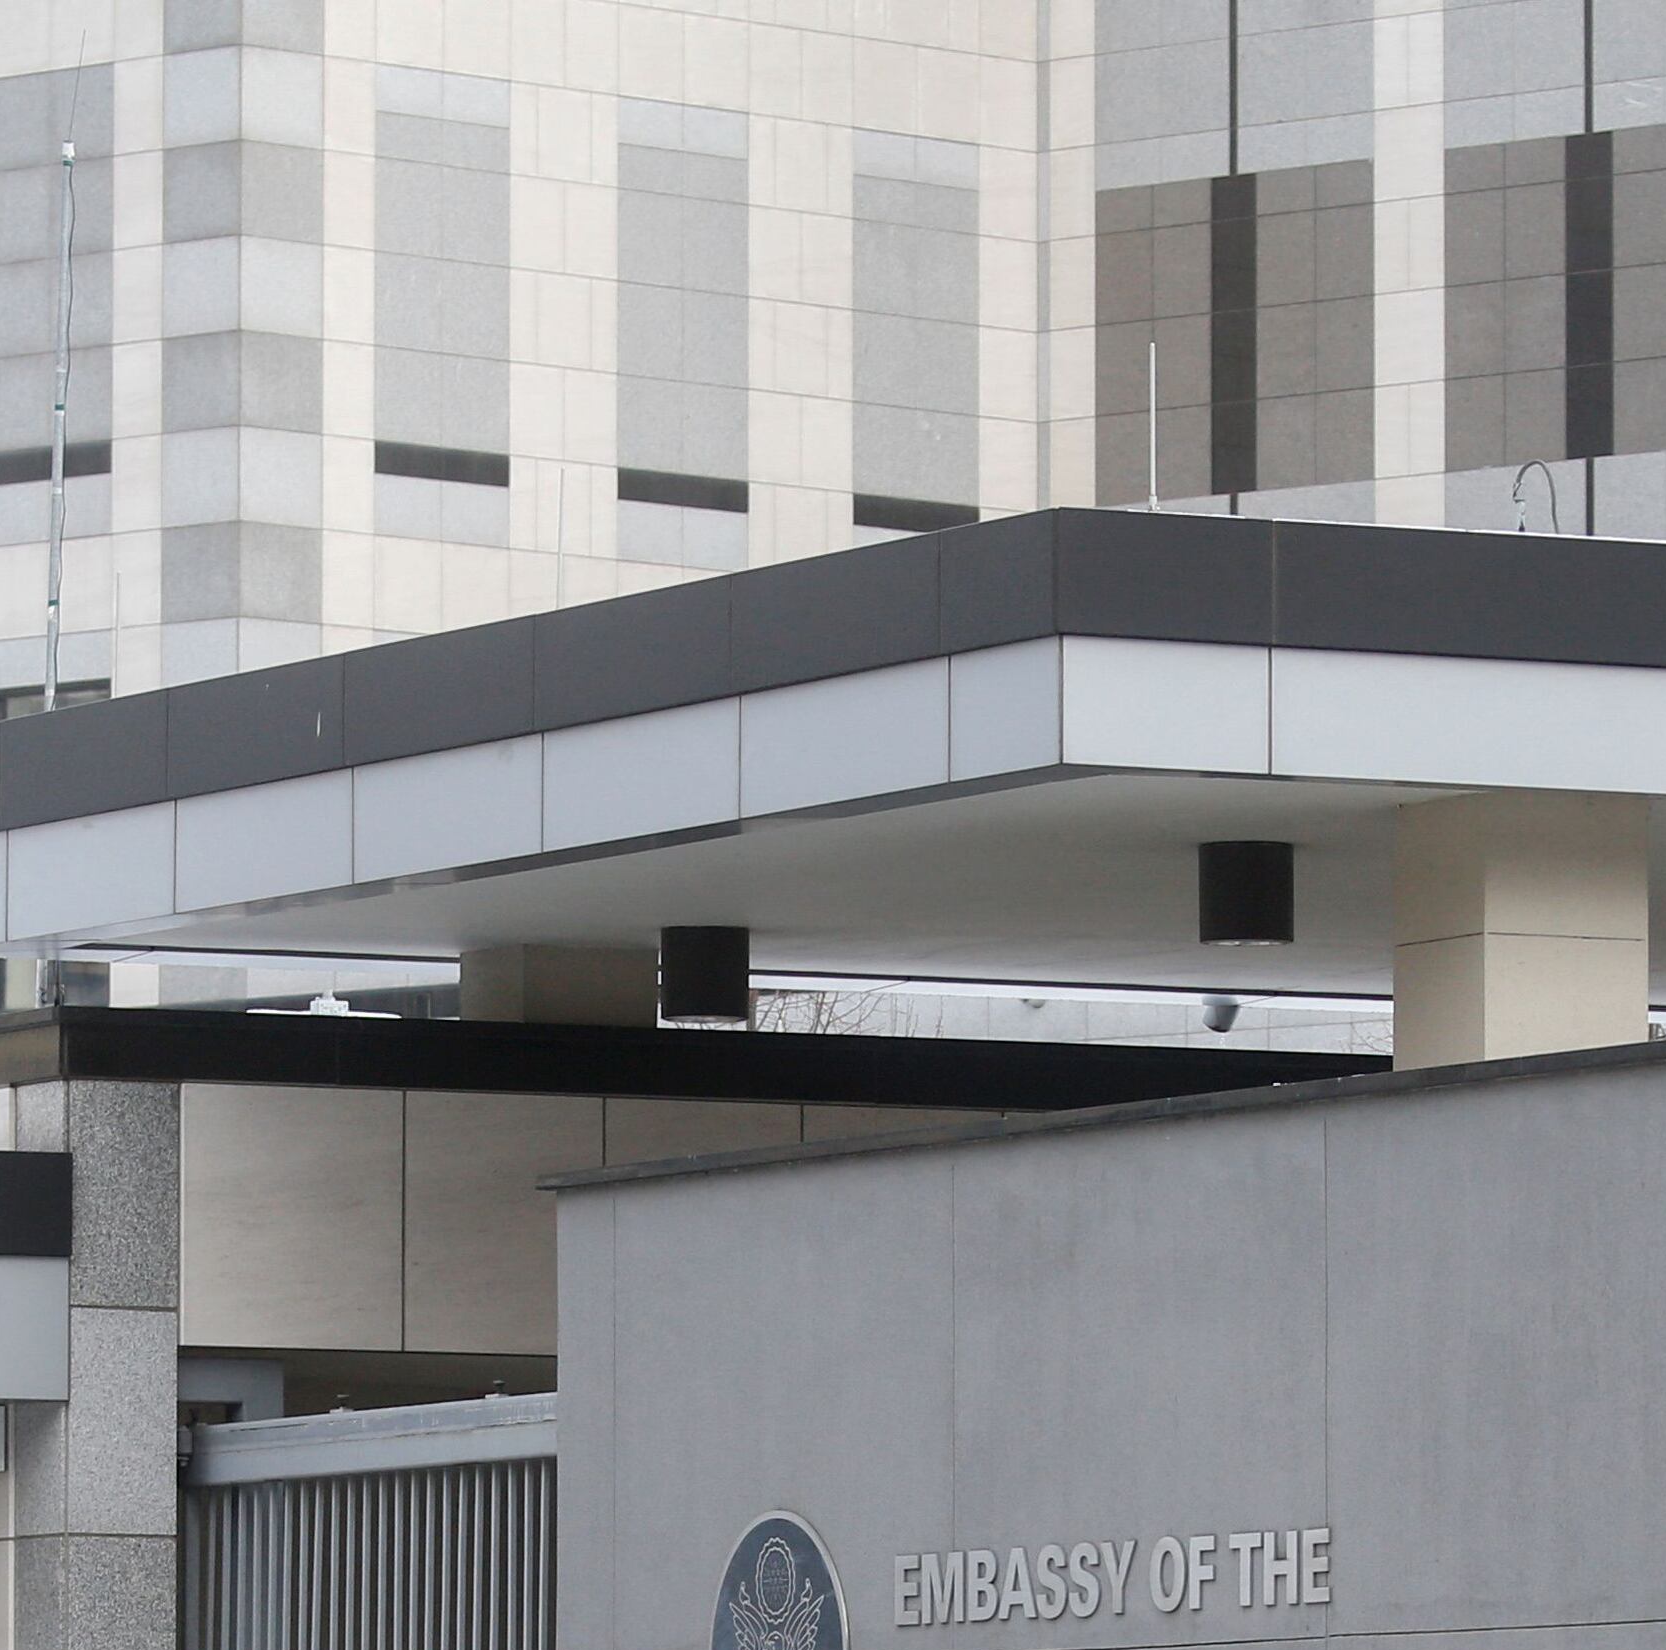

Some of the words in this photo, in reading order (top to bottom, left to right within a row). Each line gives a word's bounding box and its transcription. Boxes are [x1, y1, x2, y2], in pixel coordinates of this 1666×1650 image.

[894, 1540, 1137, 1626] EMBASSY
[1149, 1535, 1216, 1613] OF
[1229, 1528, 1331, 1607] THE
